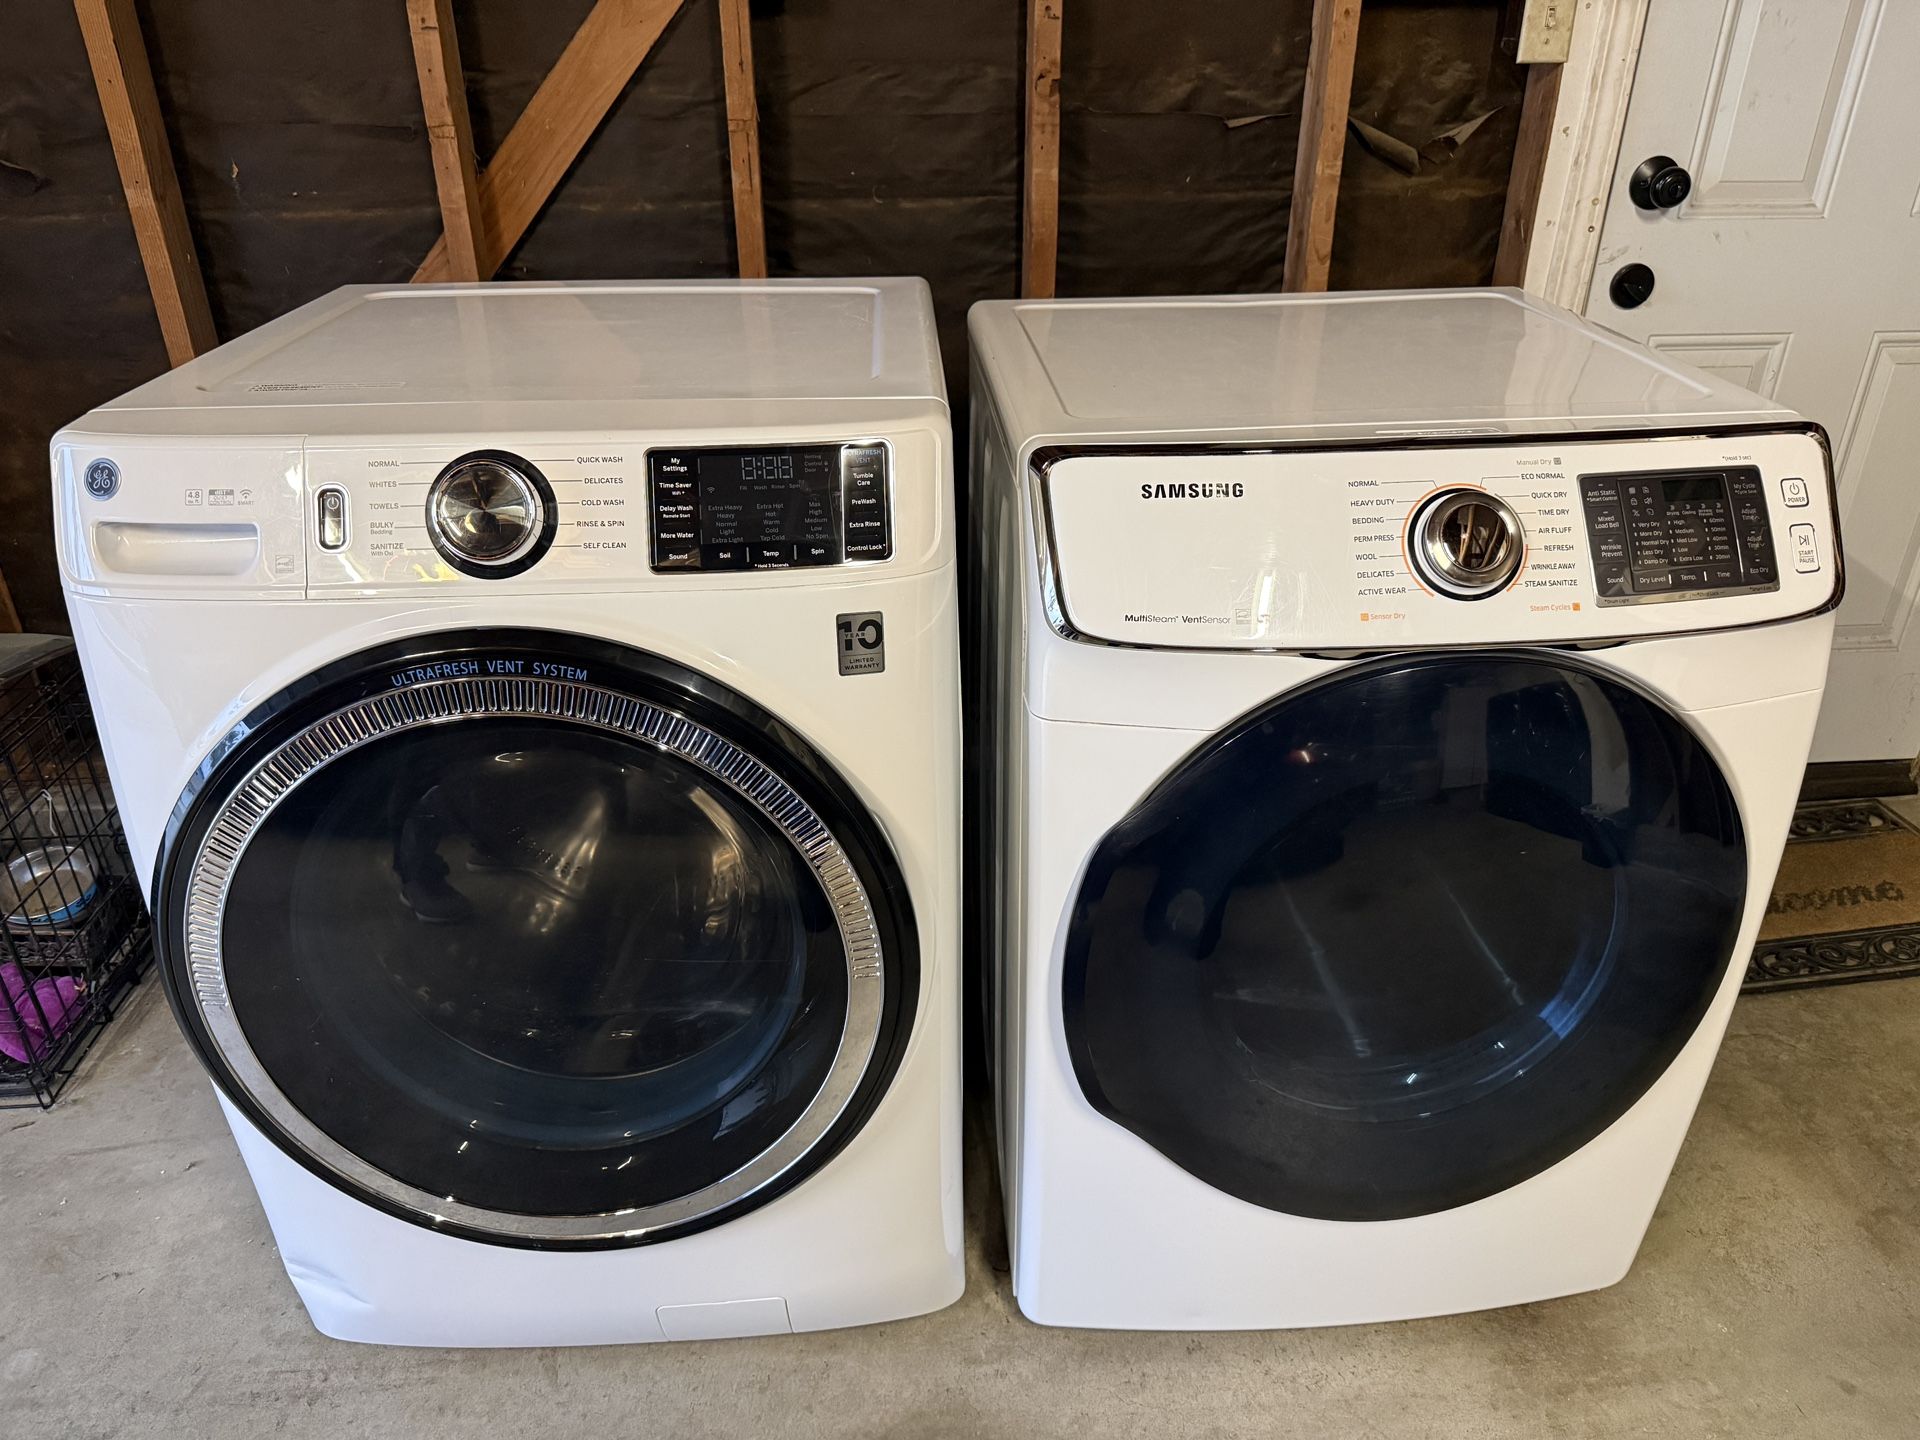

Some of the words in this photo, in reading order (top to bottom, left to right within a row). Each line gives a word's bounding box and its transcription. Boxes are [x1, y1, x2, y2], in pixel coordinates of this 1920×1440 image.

[368, 460, 400, 468] NORMAL
[576, 456, 600, 464] QUICK
[1540, 458, 1552, 466] Dry
[584, 477, 624, 485] DELICATES
[1141, 482, 1244, 499] SAMSUNG
[187, 491, 200, 499] 4.8
[370, 521, 394, 529] BULKY
[719, 528, 735, 536] Light
[728, 536, 744, 544] Light
[1357, 570, 1394, 578] DELICATES
[1358, 588, 1382, 596] ACTIVE
[1382, 587, 1406, 595] WEAR
[1530, 604, 1549, 612] Steam
[1550, 603, 1571, 612] Cycles
[1181, 615, 1231, 624] VentSensor
[1392, 612, 1405, 621] Dry
[838, 619, 882, 651] 10
[391, 660, 479, 687] ULTRAFRESH
[486, 660, 524, 673] VENT
[532, 662, 588, 681] SYSTEM
